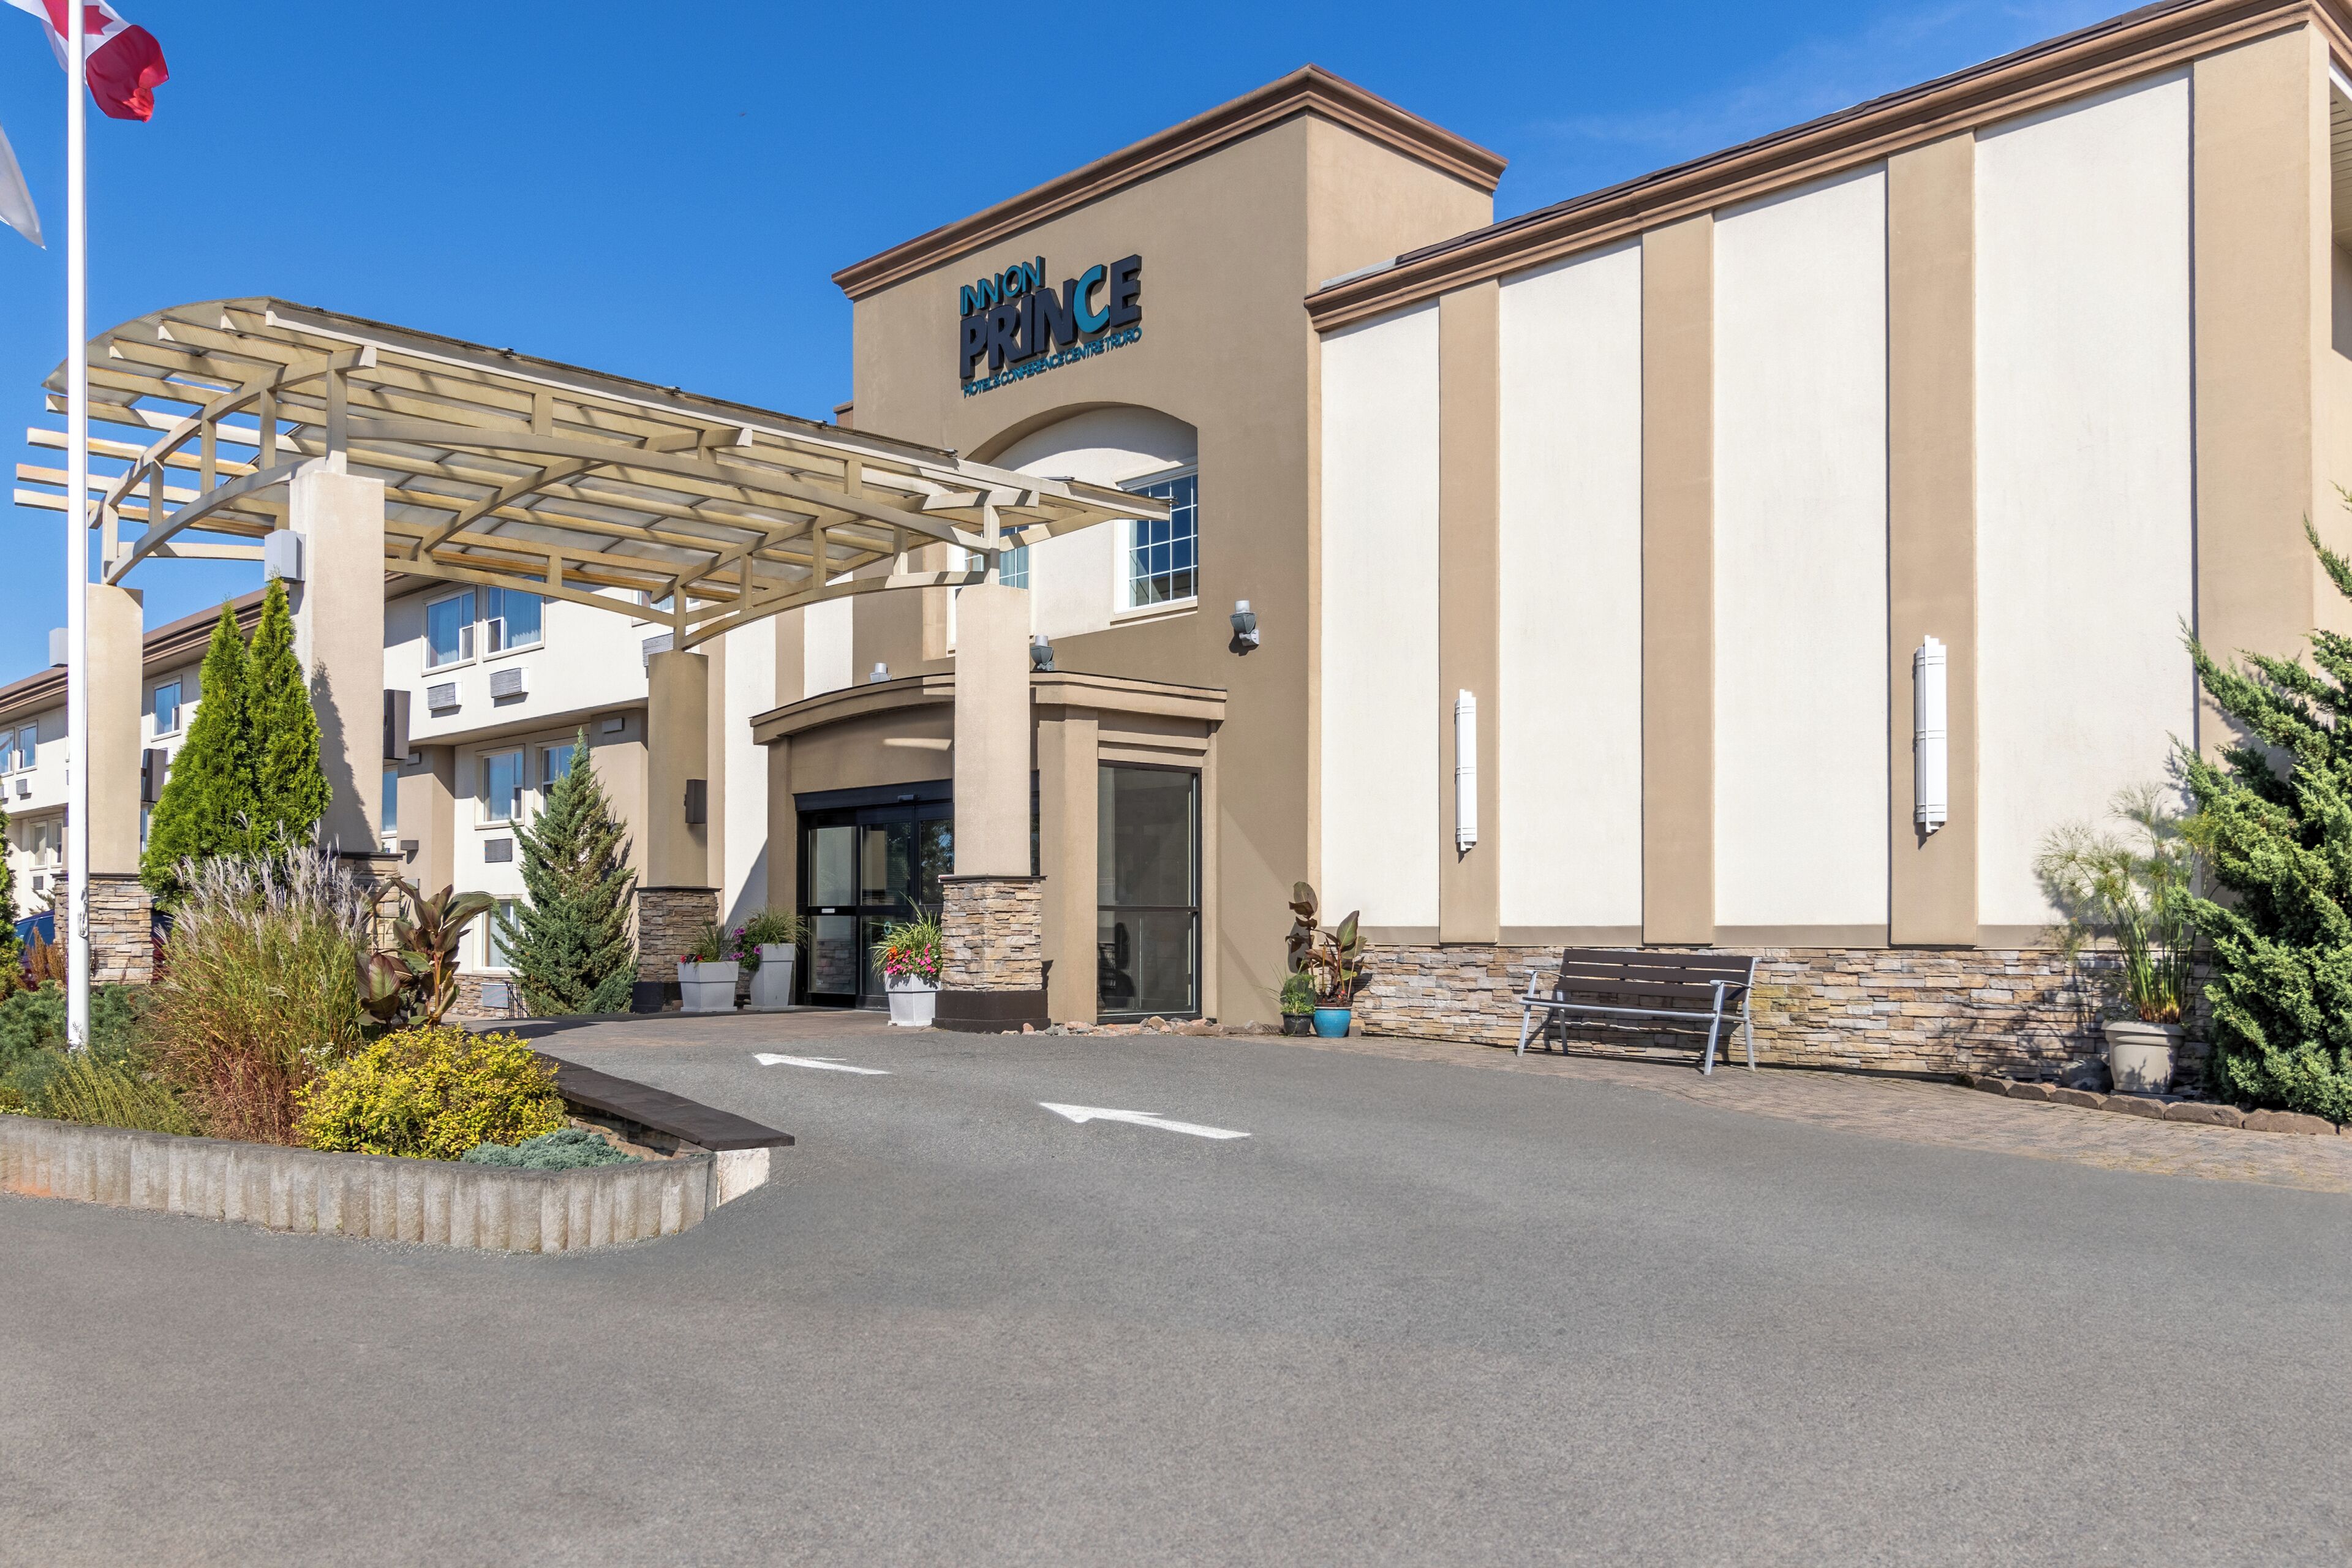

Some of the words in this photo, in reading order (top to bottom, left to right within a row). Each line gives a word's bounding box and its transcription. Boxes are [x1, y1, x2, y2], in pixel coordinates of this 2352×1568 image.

[960, 273, 1003, 315] INN
[1003, 255, 1045, 297] ON
[960, 254, 1142, 379] PRINCE
[963, 377, 993, 399] HOTEL
[992, 374, 1001, 389] &
[1000, 351, 1065, 386] CONFERENCE
[1065, 339, 1105, 365] CENTRE
[1103, 325, 1142, 353] TRURO
